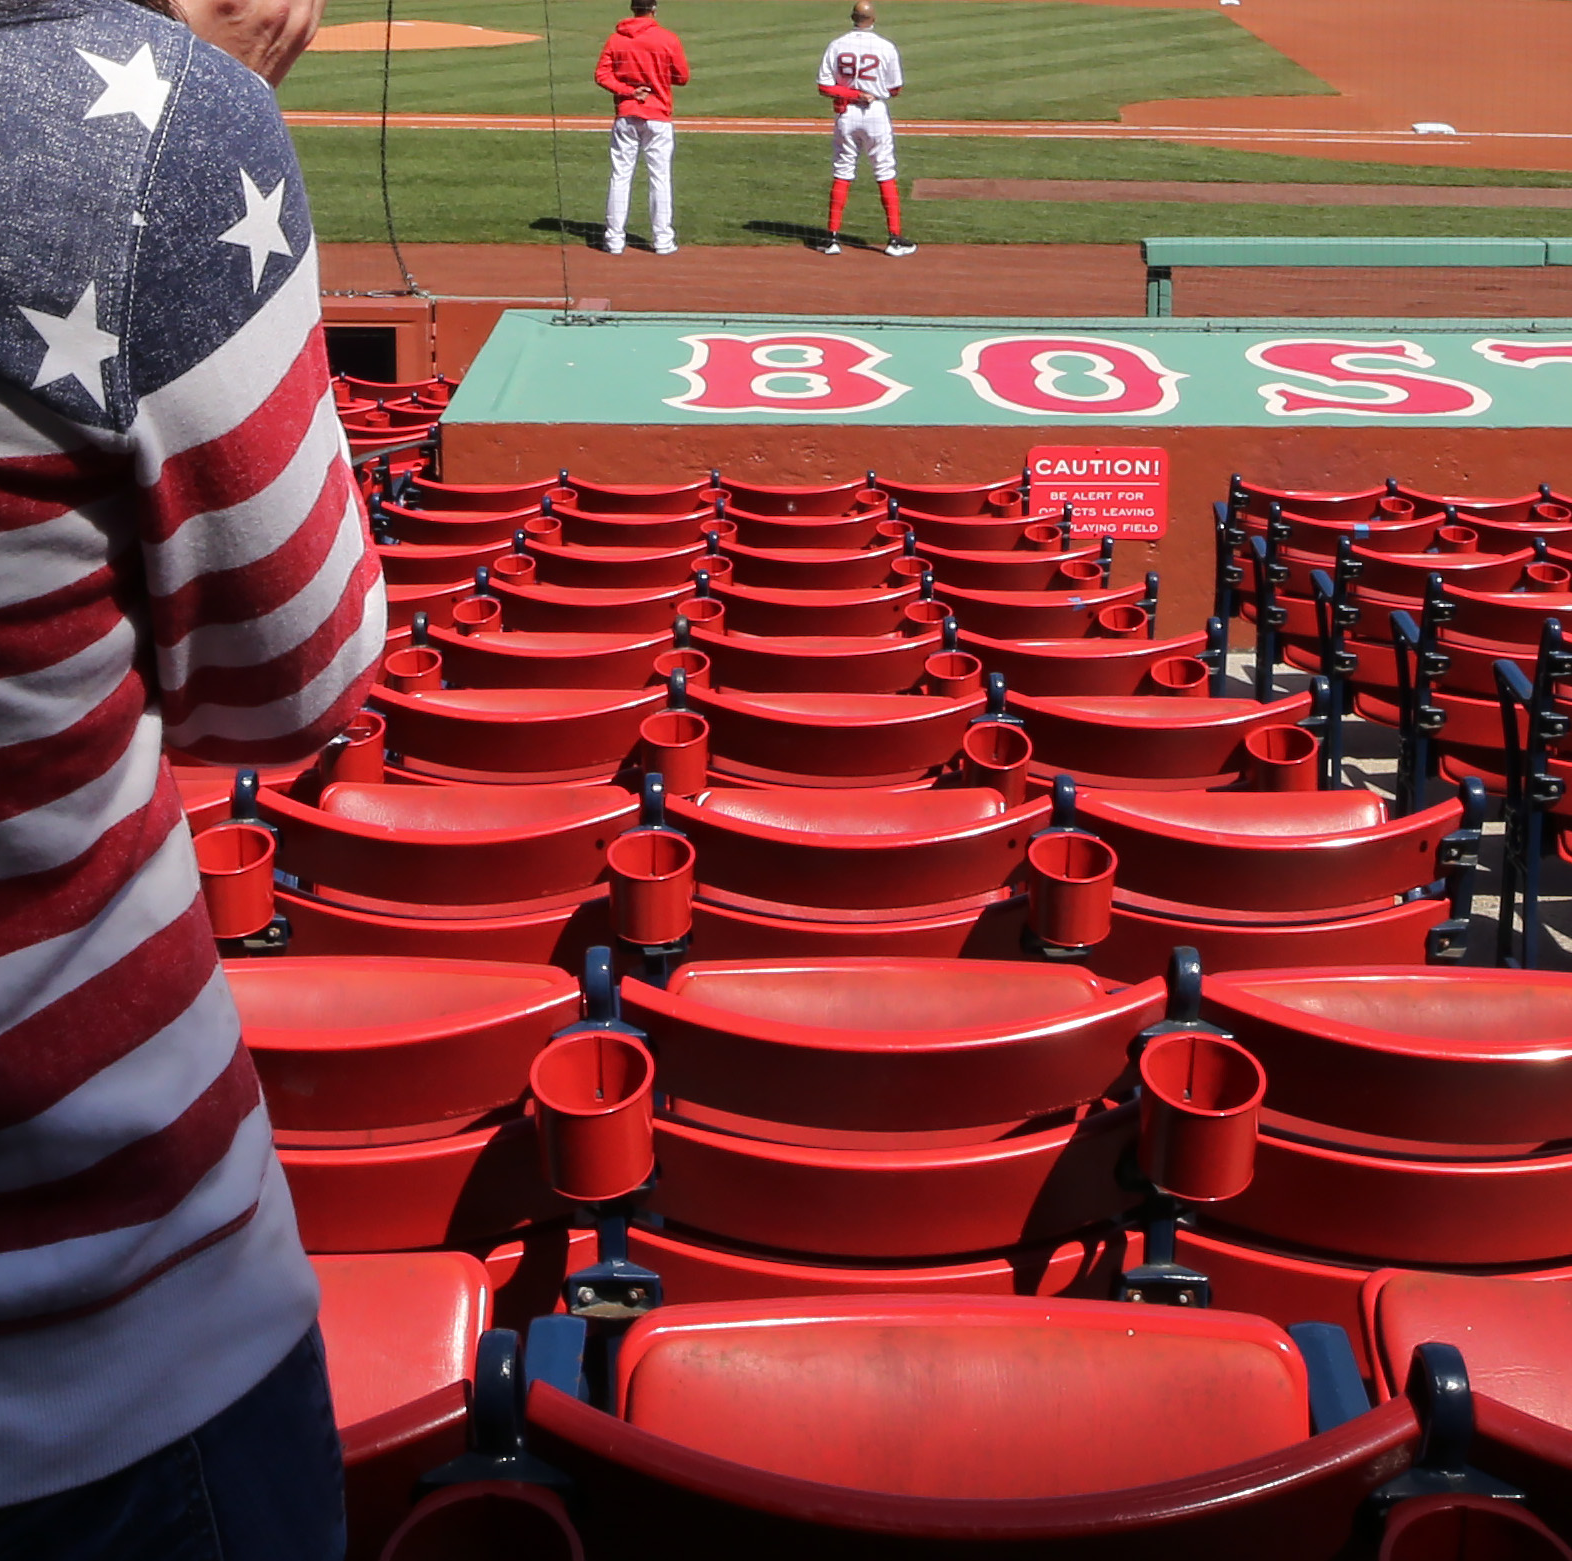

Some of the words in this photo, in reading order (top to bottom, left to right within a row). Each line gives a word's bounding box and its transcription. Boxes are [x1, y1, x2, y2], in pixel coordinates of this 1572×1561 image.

[837, 52, 881, 82] 82
[1035, 459, 1160, 476] CAUTION!
[1050, 491, 1068, 501] BE
[1072, 491, 1113, 501] ALERT
[1117, 491, 1144, 501] FOR
[1102, 507, 1155, 517] LEAVING
[1122, 523, 1159, 533] FIELD
